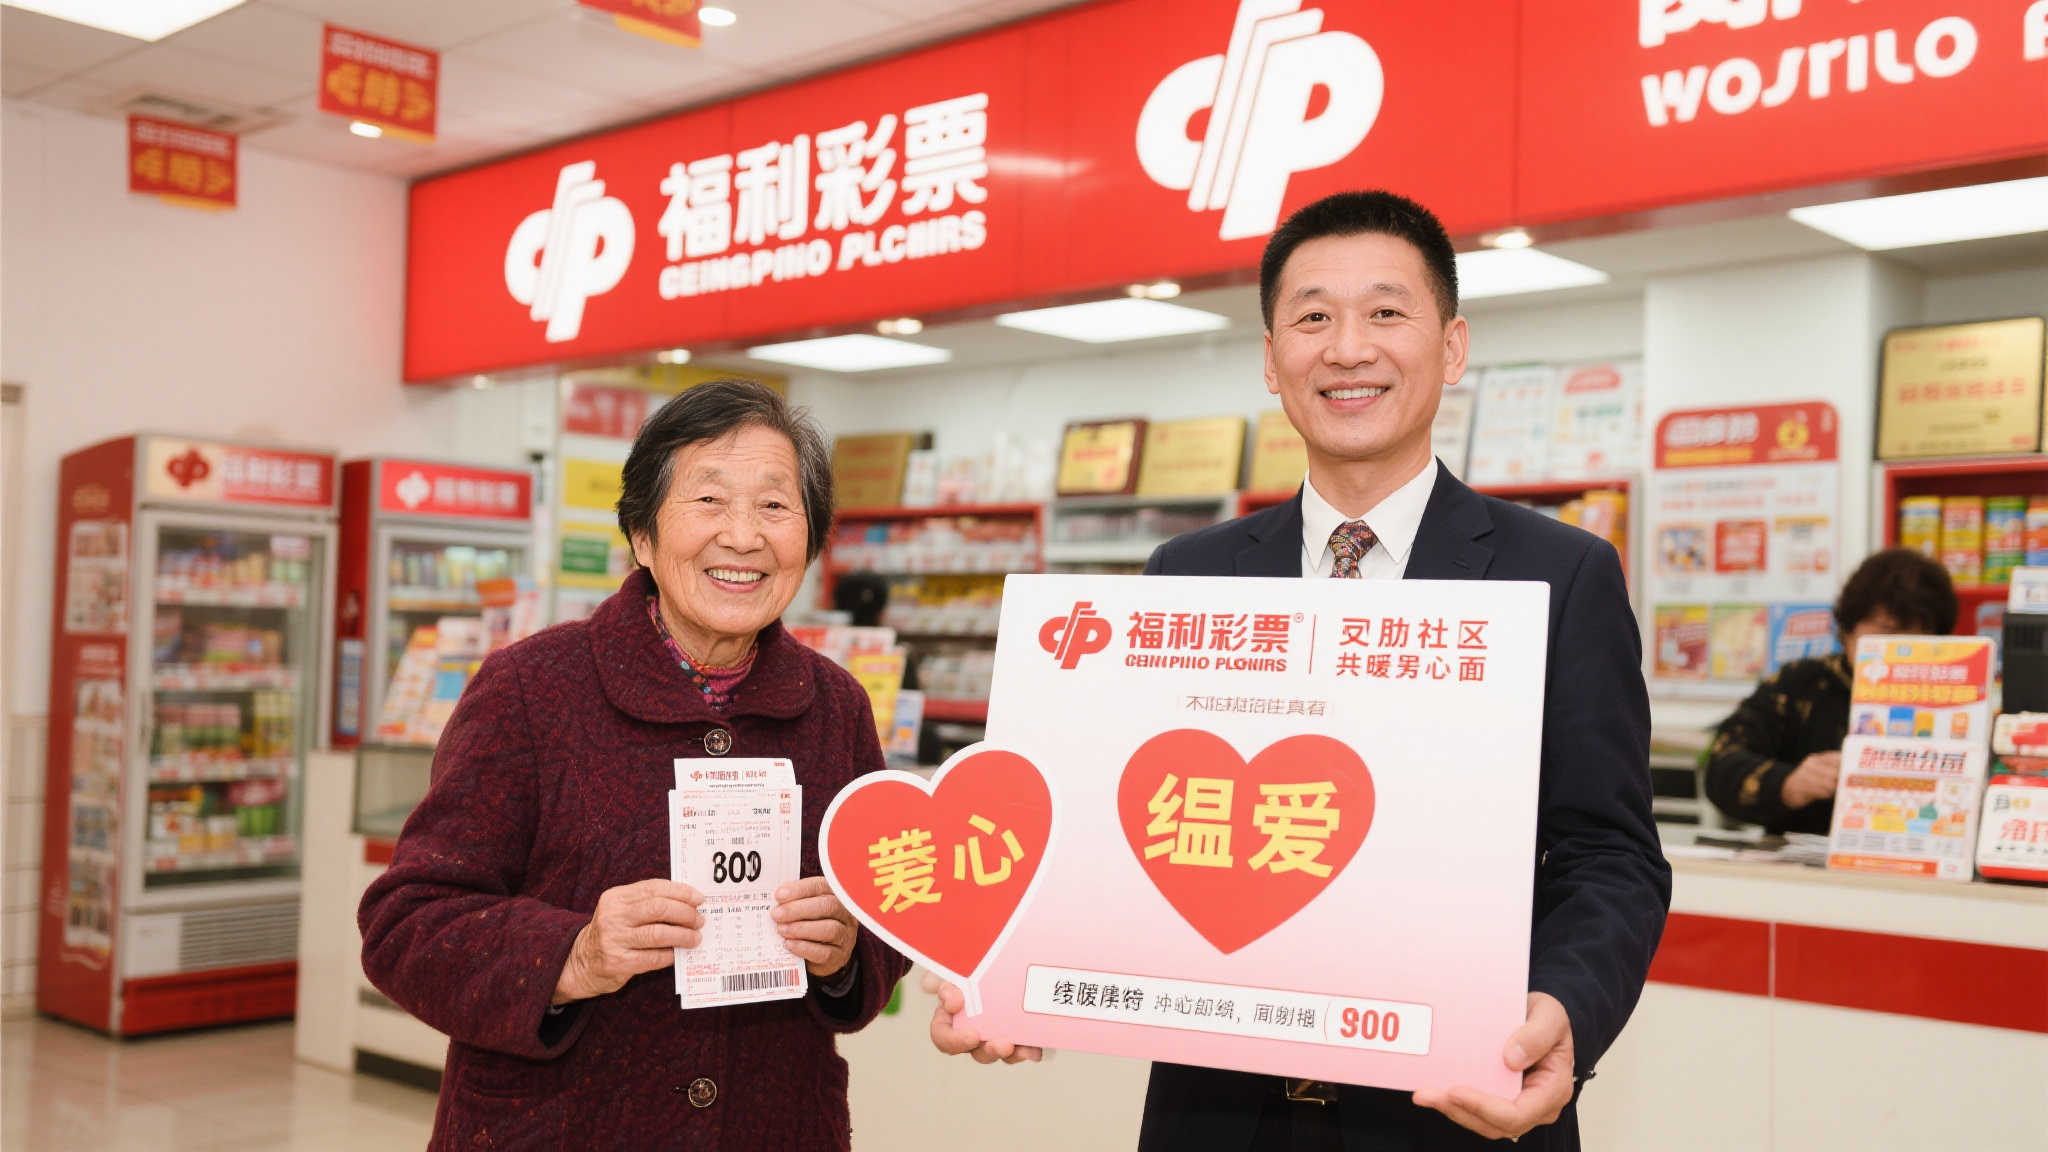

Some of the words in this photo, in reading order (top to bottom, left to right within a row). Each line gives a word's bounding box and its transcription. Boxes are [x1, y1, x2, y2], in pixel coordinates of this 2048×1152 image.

[657, 92, 989, 262] 福利彩票
[1126, 611, 1291, 654] 福利彩票
